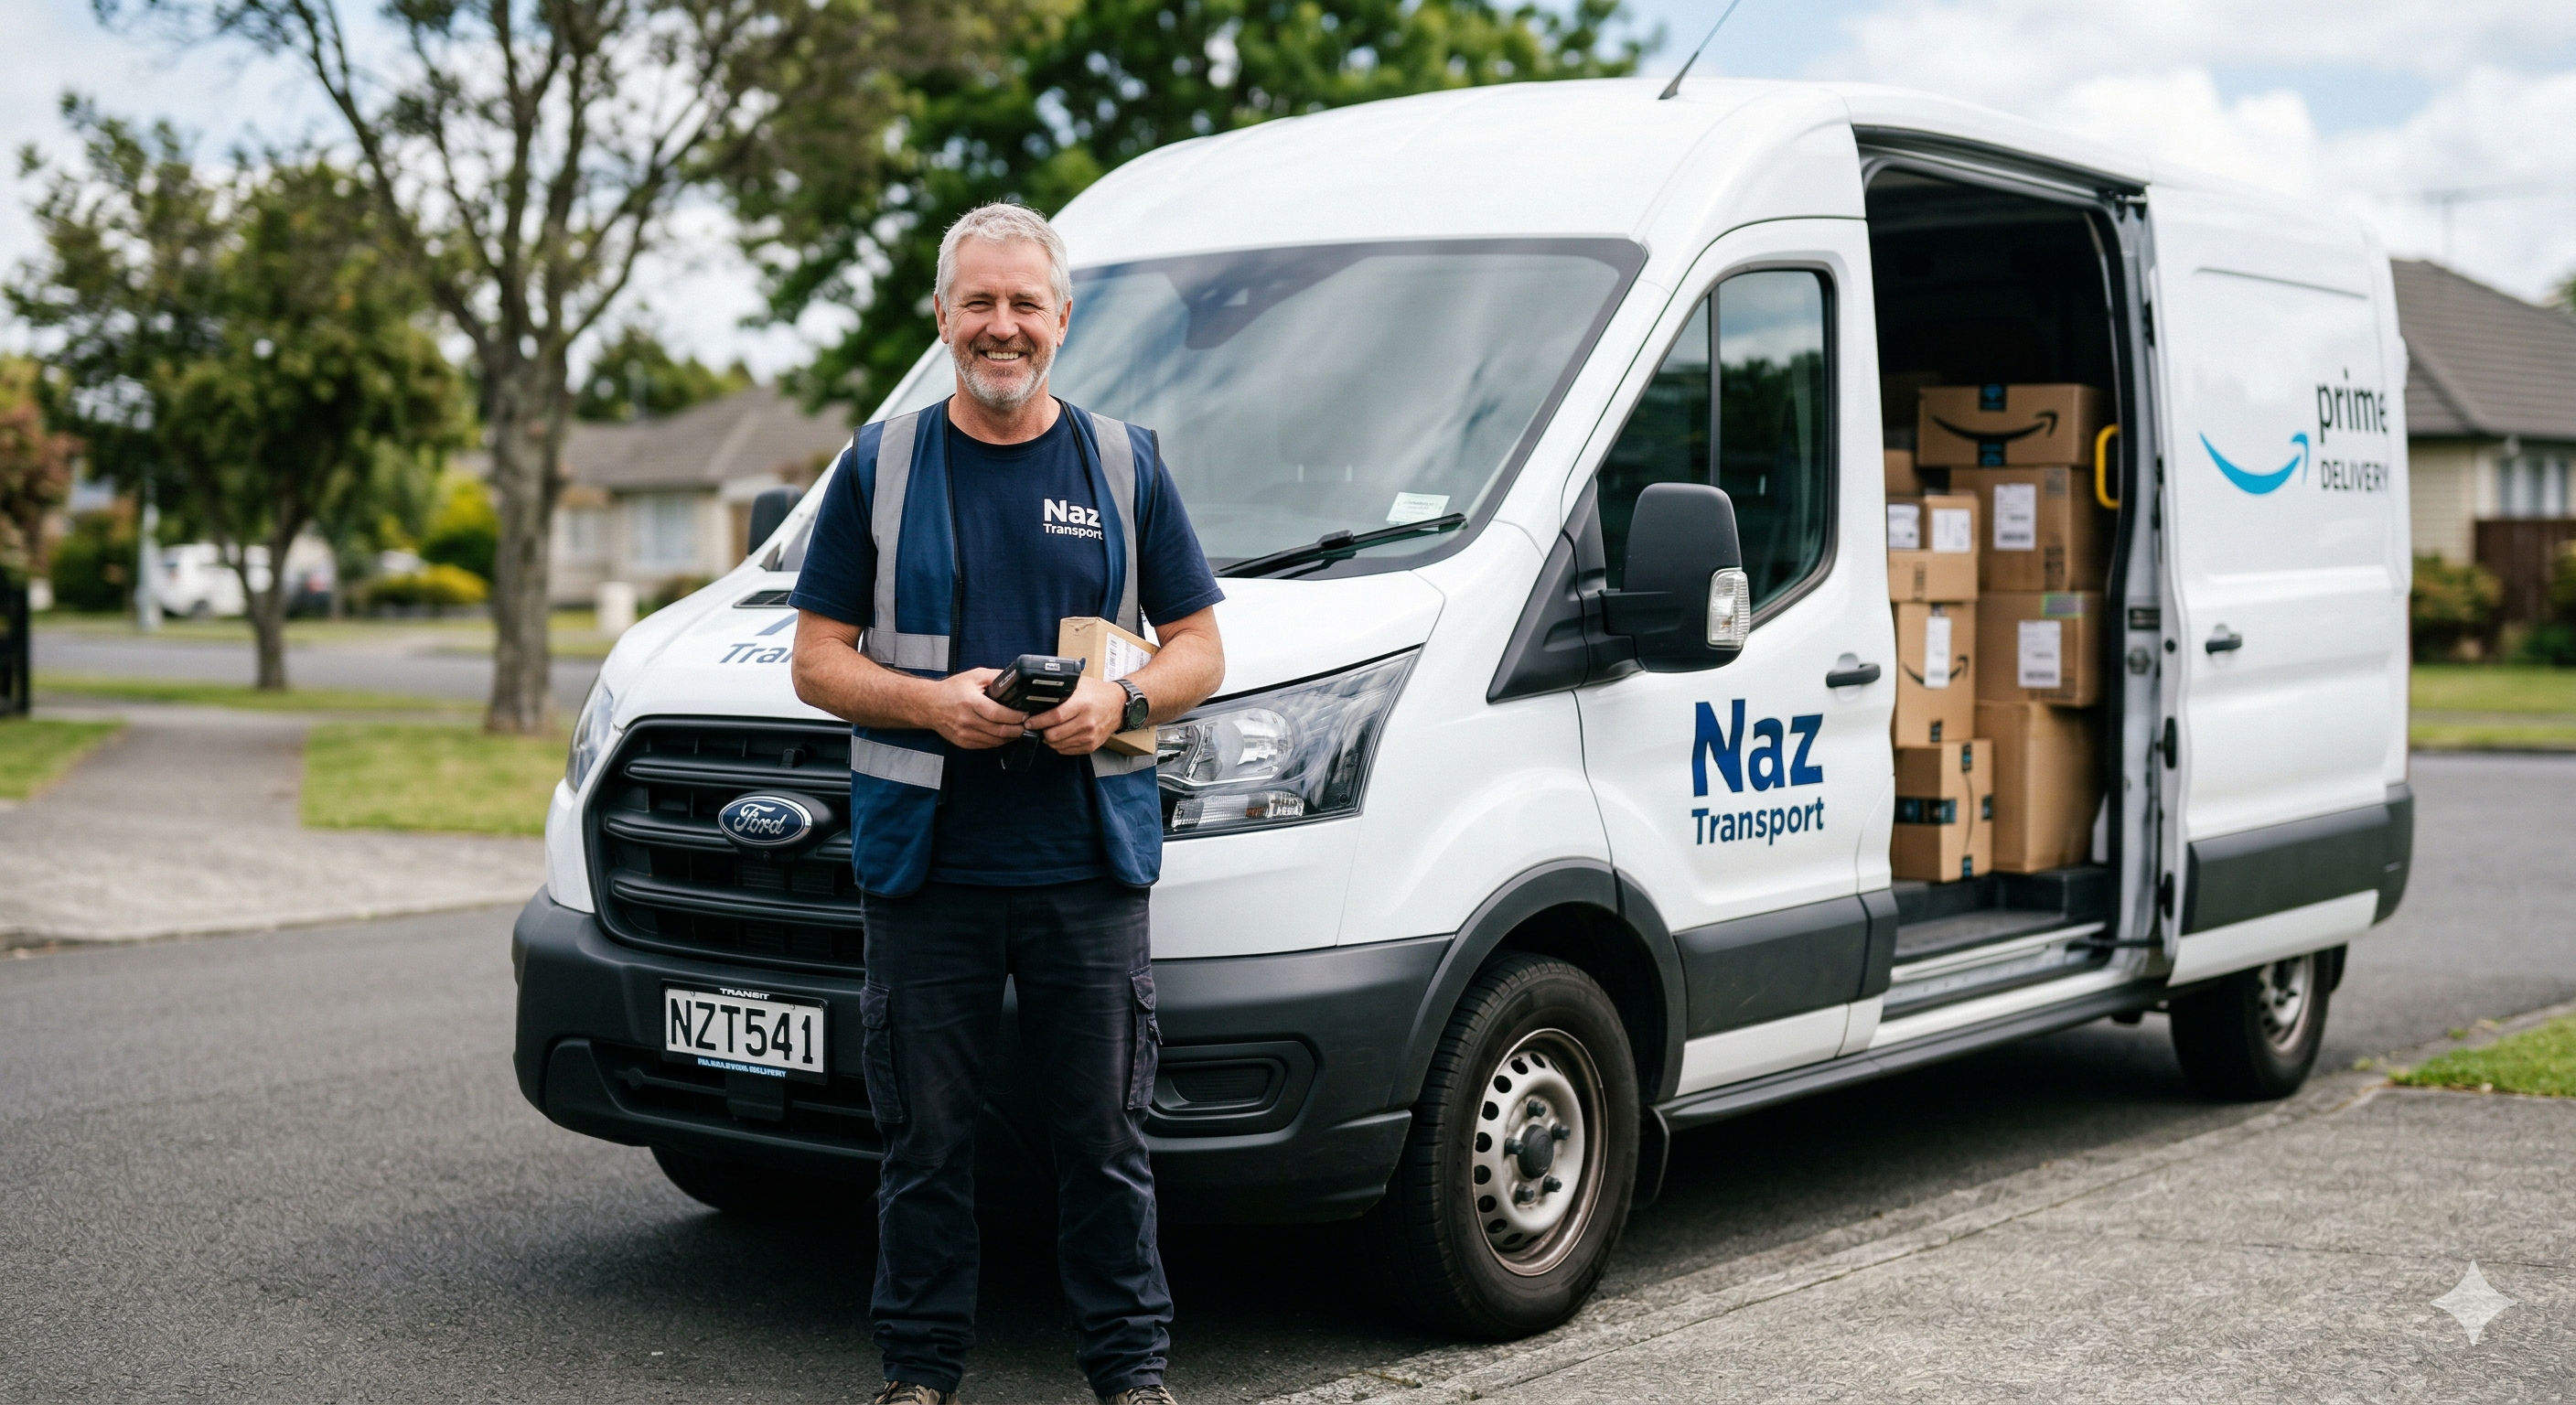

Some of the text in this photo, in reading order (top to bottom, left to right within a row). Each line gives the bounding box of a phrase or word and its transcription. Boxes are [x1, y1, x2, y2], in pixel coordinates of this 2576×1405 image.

[2317, 368, 2387, 444] prime
[2321, 459, 2388, 491] DELIVERY
[1044, 499, 1101, 528] Naz
[1043, 523, 1103, 540] Transport
[1691, 698, 1823, 797] Naz
[734, 803, 788, 834] Ford
[1691, 797, 1824, 846] Transport
[719, 988, 770, 1000] TRANSIT
[671, 998, 813, 1064] NZT541
